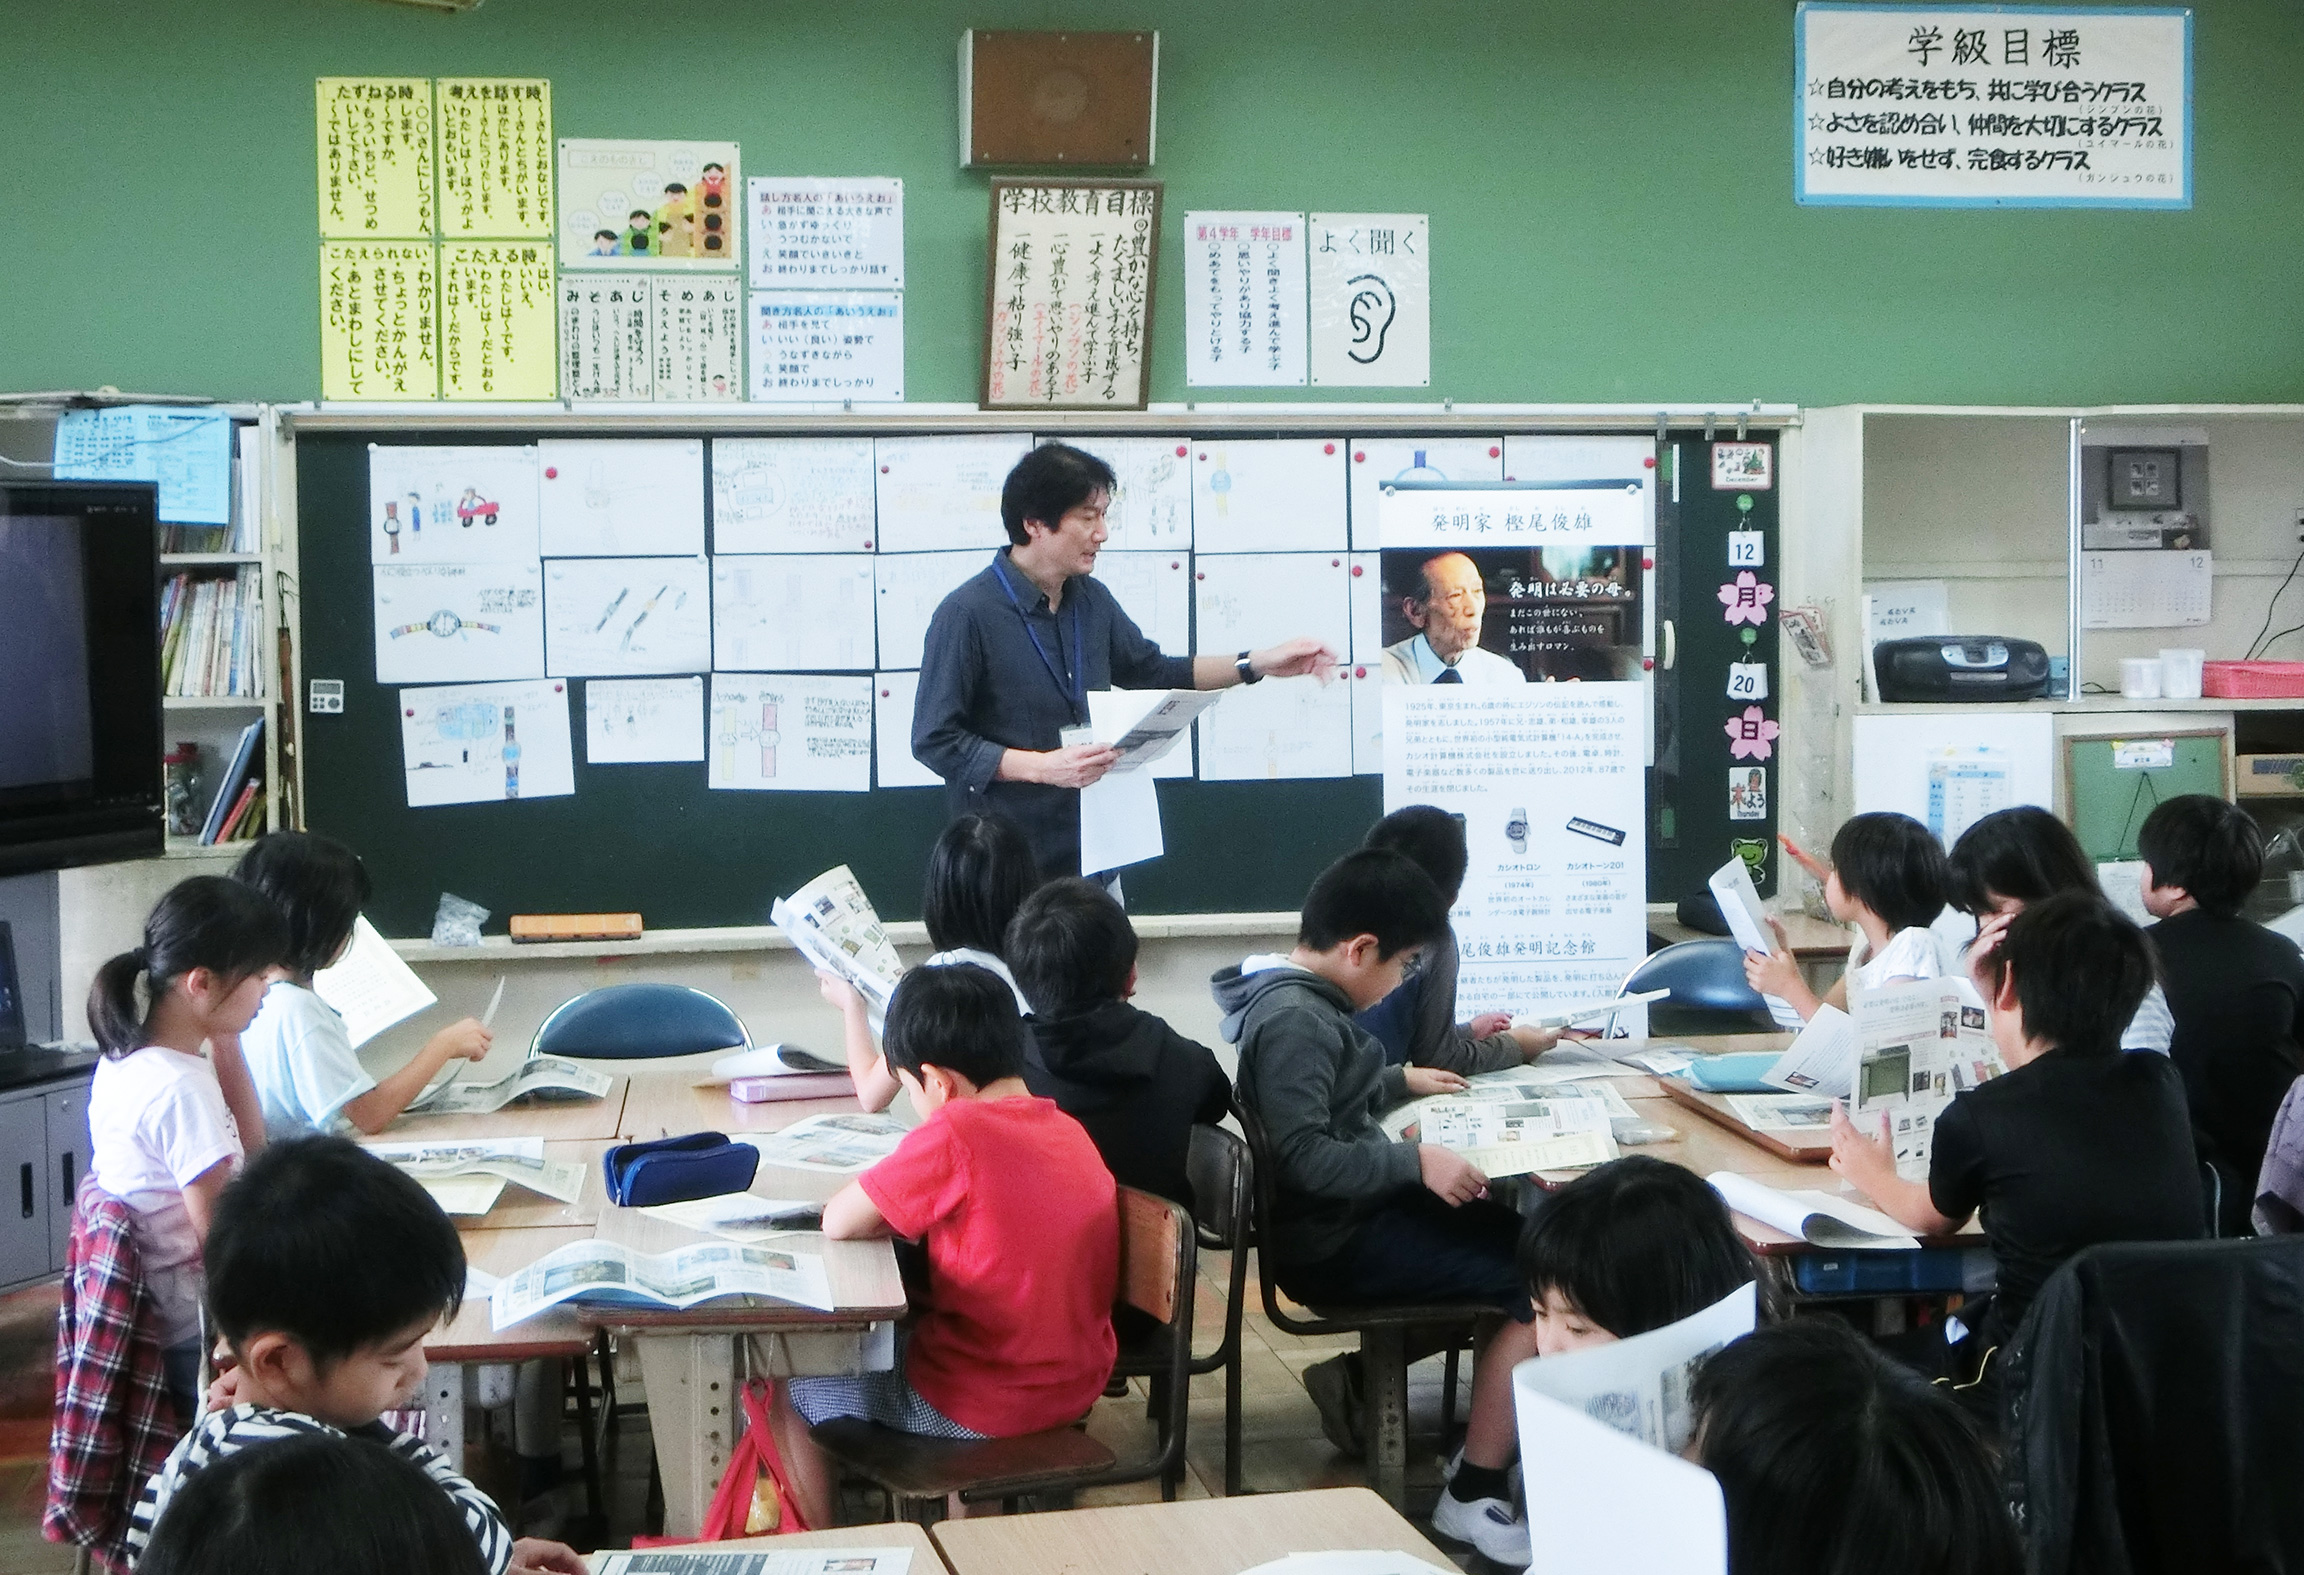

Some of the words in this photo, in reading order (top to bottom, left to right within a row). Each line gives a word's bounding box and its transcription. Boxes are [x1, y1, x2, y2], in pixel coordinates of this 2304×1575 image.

[1908, 26, 2082, 68] 学級目標
[337, 84, 414, 100] たずねる時
[450, 84, 541, 100] 考えを話す時
[1003, 188, 1153, 217] 学校教育目標
[1250, 226, 1292, 241] 学年目標
[1319, 229, 1415, 255] よく聞く
[330, 248, 428, 260] こたえられない
[455, 249, 537, 262] こたえる時
[1431, 512, 1494, 532] 発明家
[1735, 543, 1755, 560] 12
[2090, 558, 2104, 569] 11
[2190, 556, 2204, 569] 12
[1736, 586, 1756, 607] 月
[1734, 674, 1755, 693] 20
[1741, 720, 1759, 740] 日
[1497, 864, 1541, 872] カシオトロン
